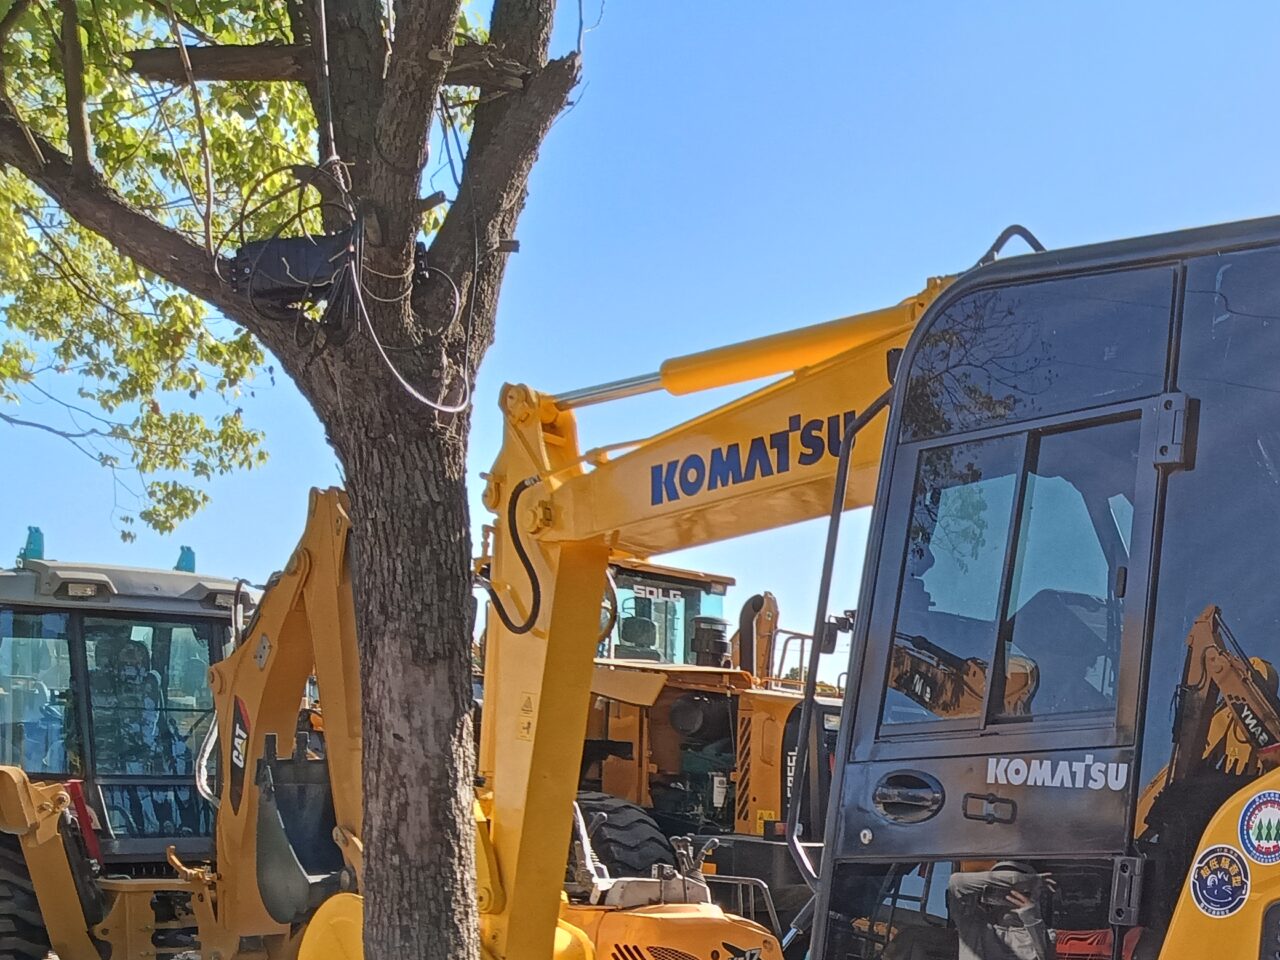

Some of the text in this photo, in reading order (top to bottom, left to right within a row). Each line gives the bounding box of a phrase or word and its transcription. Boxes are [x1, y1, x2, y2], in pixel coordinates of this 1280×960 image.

[651, 410, 856, 506] KOMATSU
[233, 723, 247, 768] CAT
[986, 754, 1128, 791] KOMATSU
